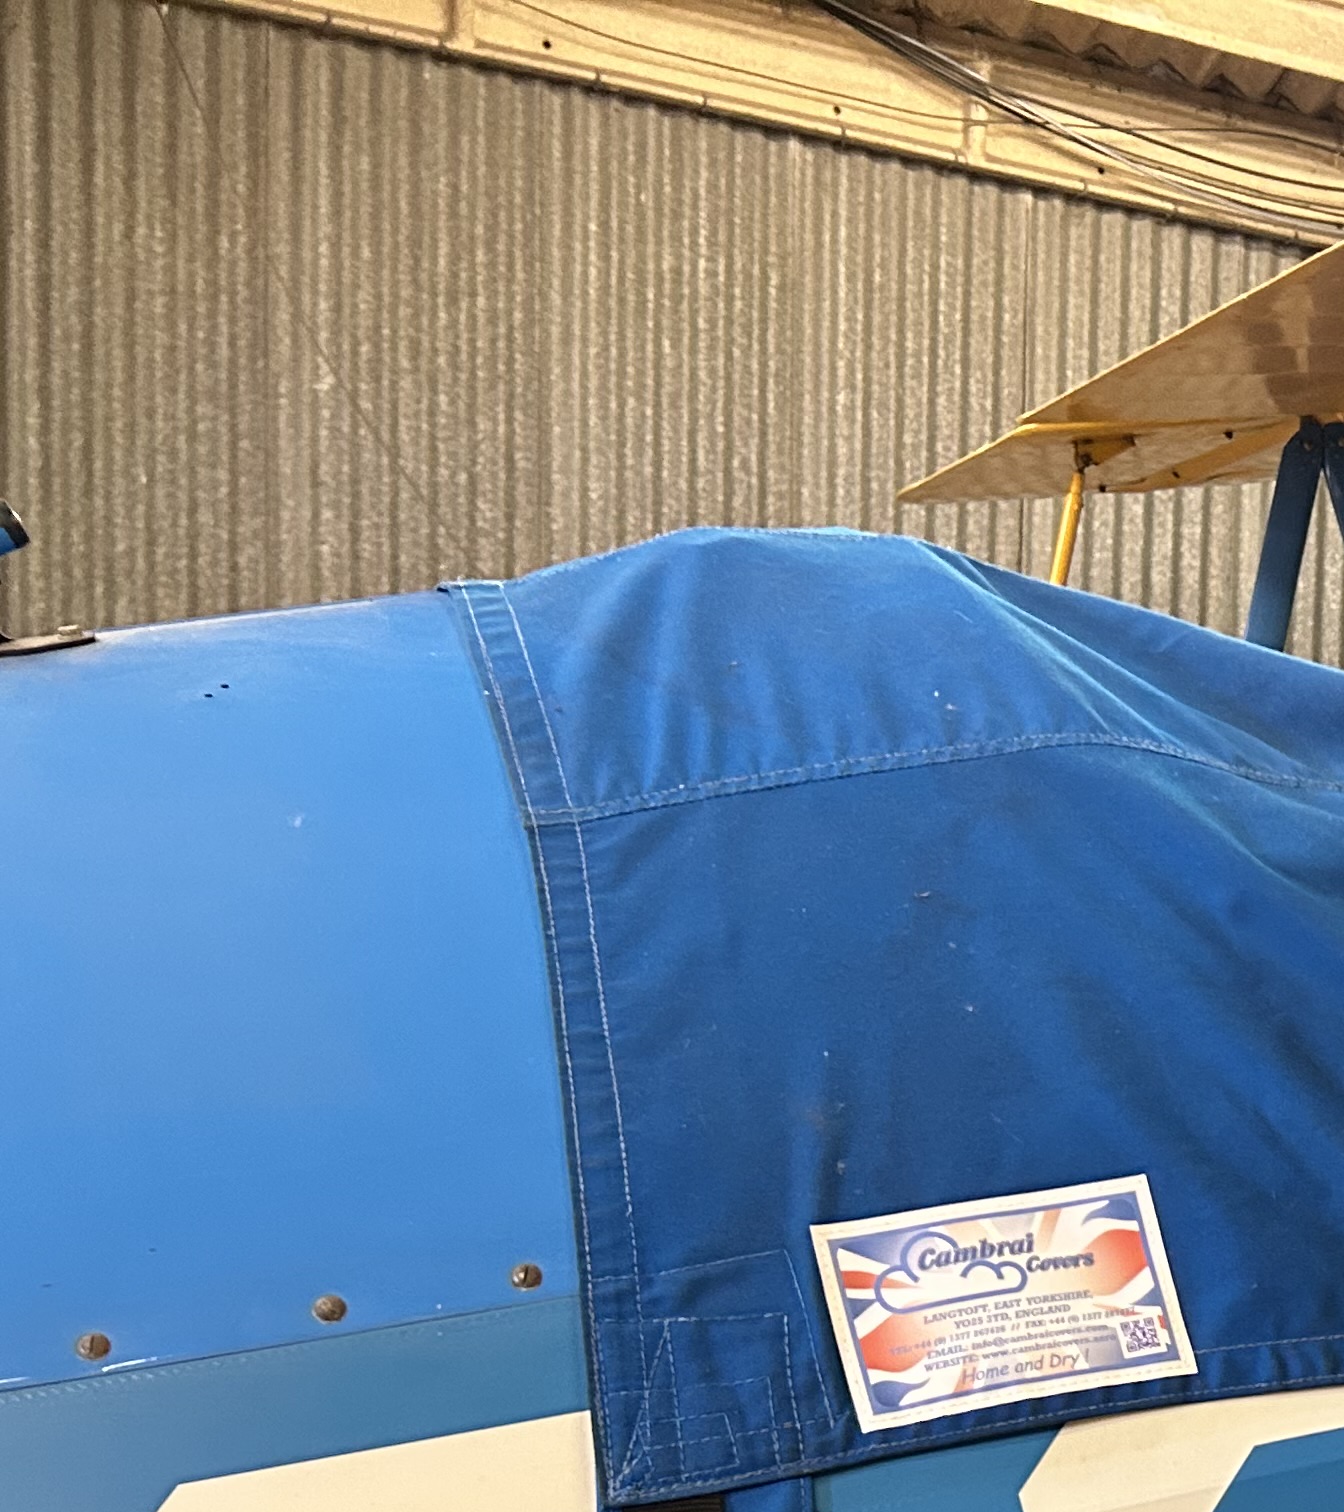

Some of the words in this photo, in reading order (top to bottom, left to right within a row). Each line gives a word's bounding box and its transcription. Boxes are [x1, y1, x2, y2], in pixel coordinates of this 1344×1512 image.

[917, 1232, 1035, 1271] Cambrai
[1026, 1252, 1095, 1273] Covers
[923, 1304, 992, 1325] LANGTOFT,
[994, 1299, 1022, 1311] EAST
[1026, 1289, 1094, 1306] YORKSHIRE,
[1015, 1303, 1071, 1320] ENGLAND
[923, 1353, 980, 1373] WEBSITE:
[927, 1345, 969, 1360] EMAIL:
[961, 1364, 1010, 1386] Home
[1014, 1354, 1045, 1374] and
[1049, 1353, 1080, 1370] Dry
